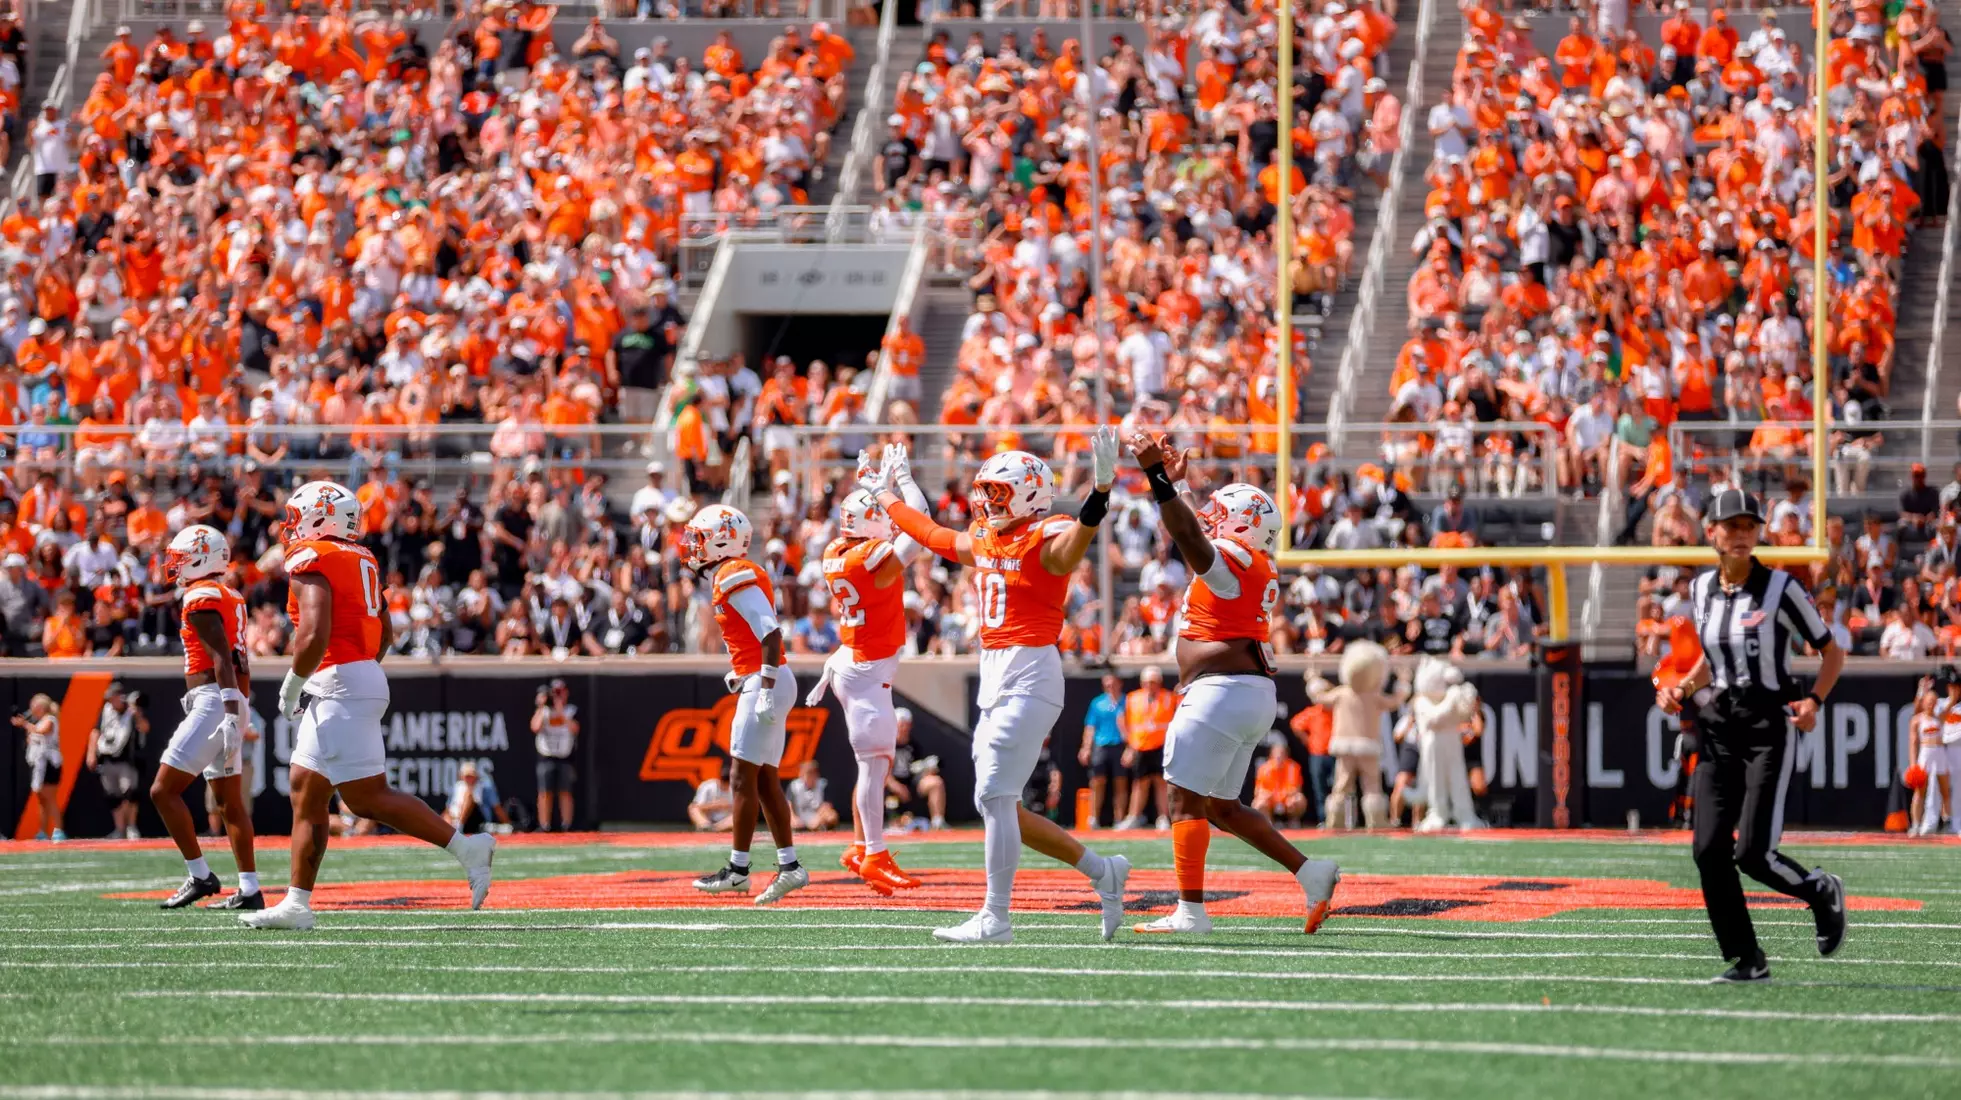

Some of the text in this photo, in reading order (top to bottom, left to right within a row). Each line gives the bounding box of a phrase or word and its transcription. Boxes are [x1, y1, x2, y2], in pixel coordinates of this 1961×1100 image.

[360, 558, 380, 617] 0
[975, 571, 1006, 629] 10
[1746, 637, 1760, 657] C
